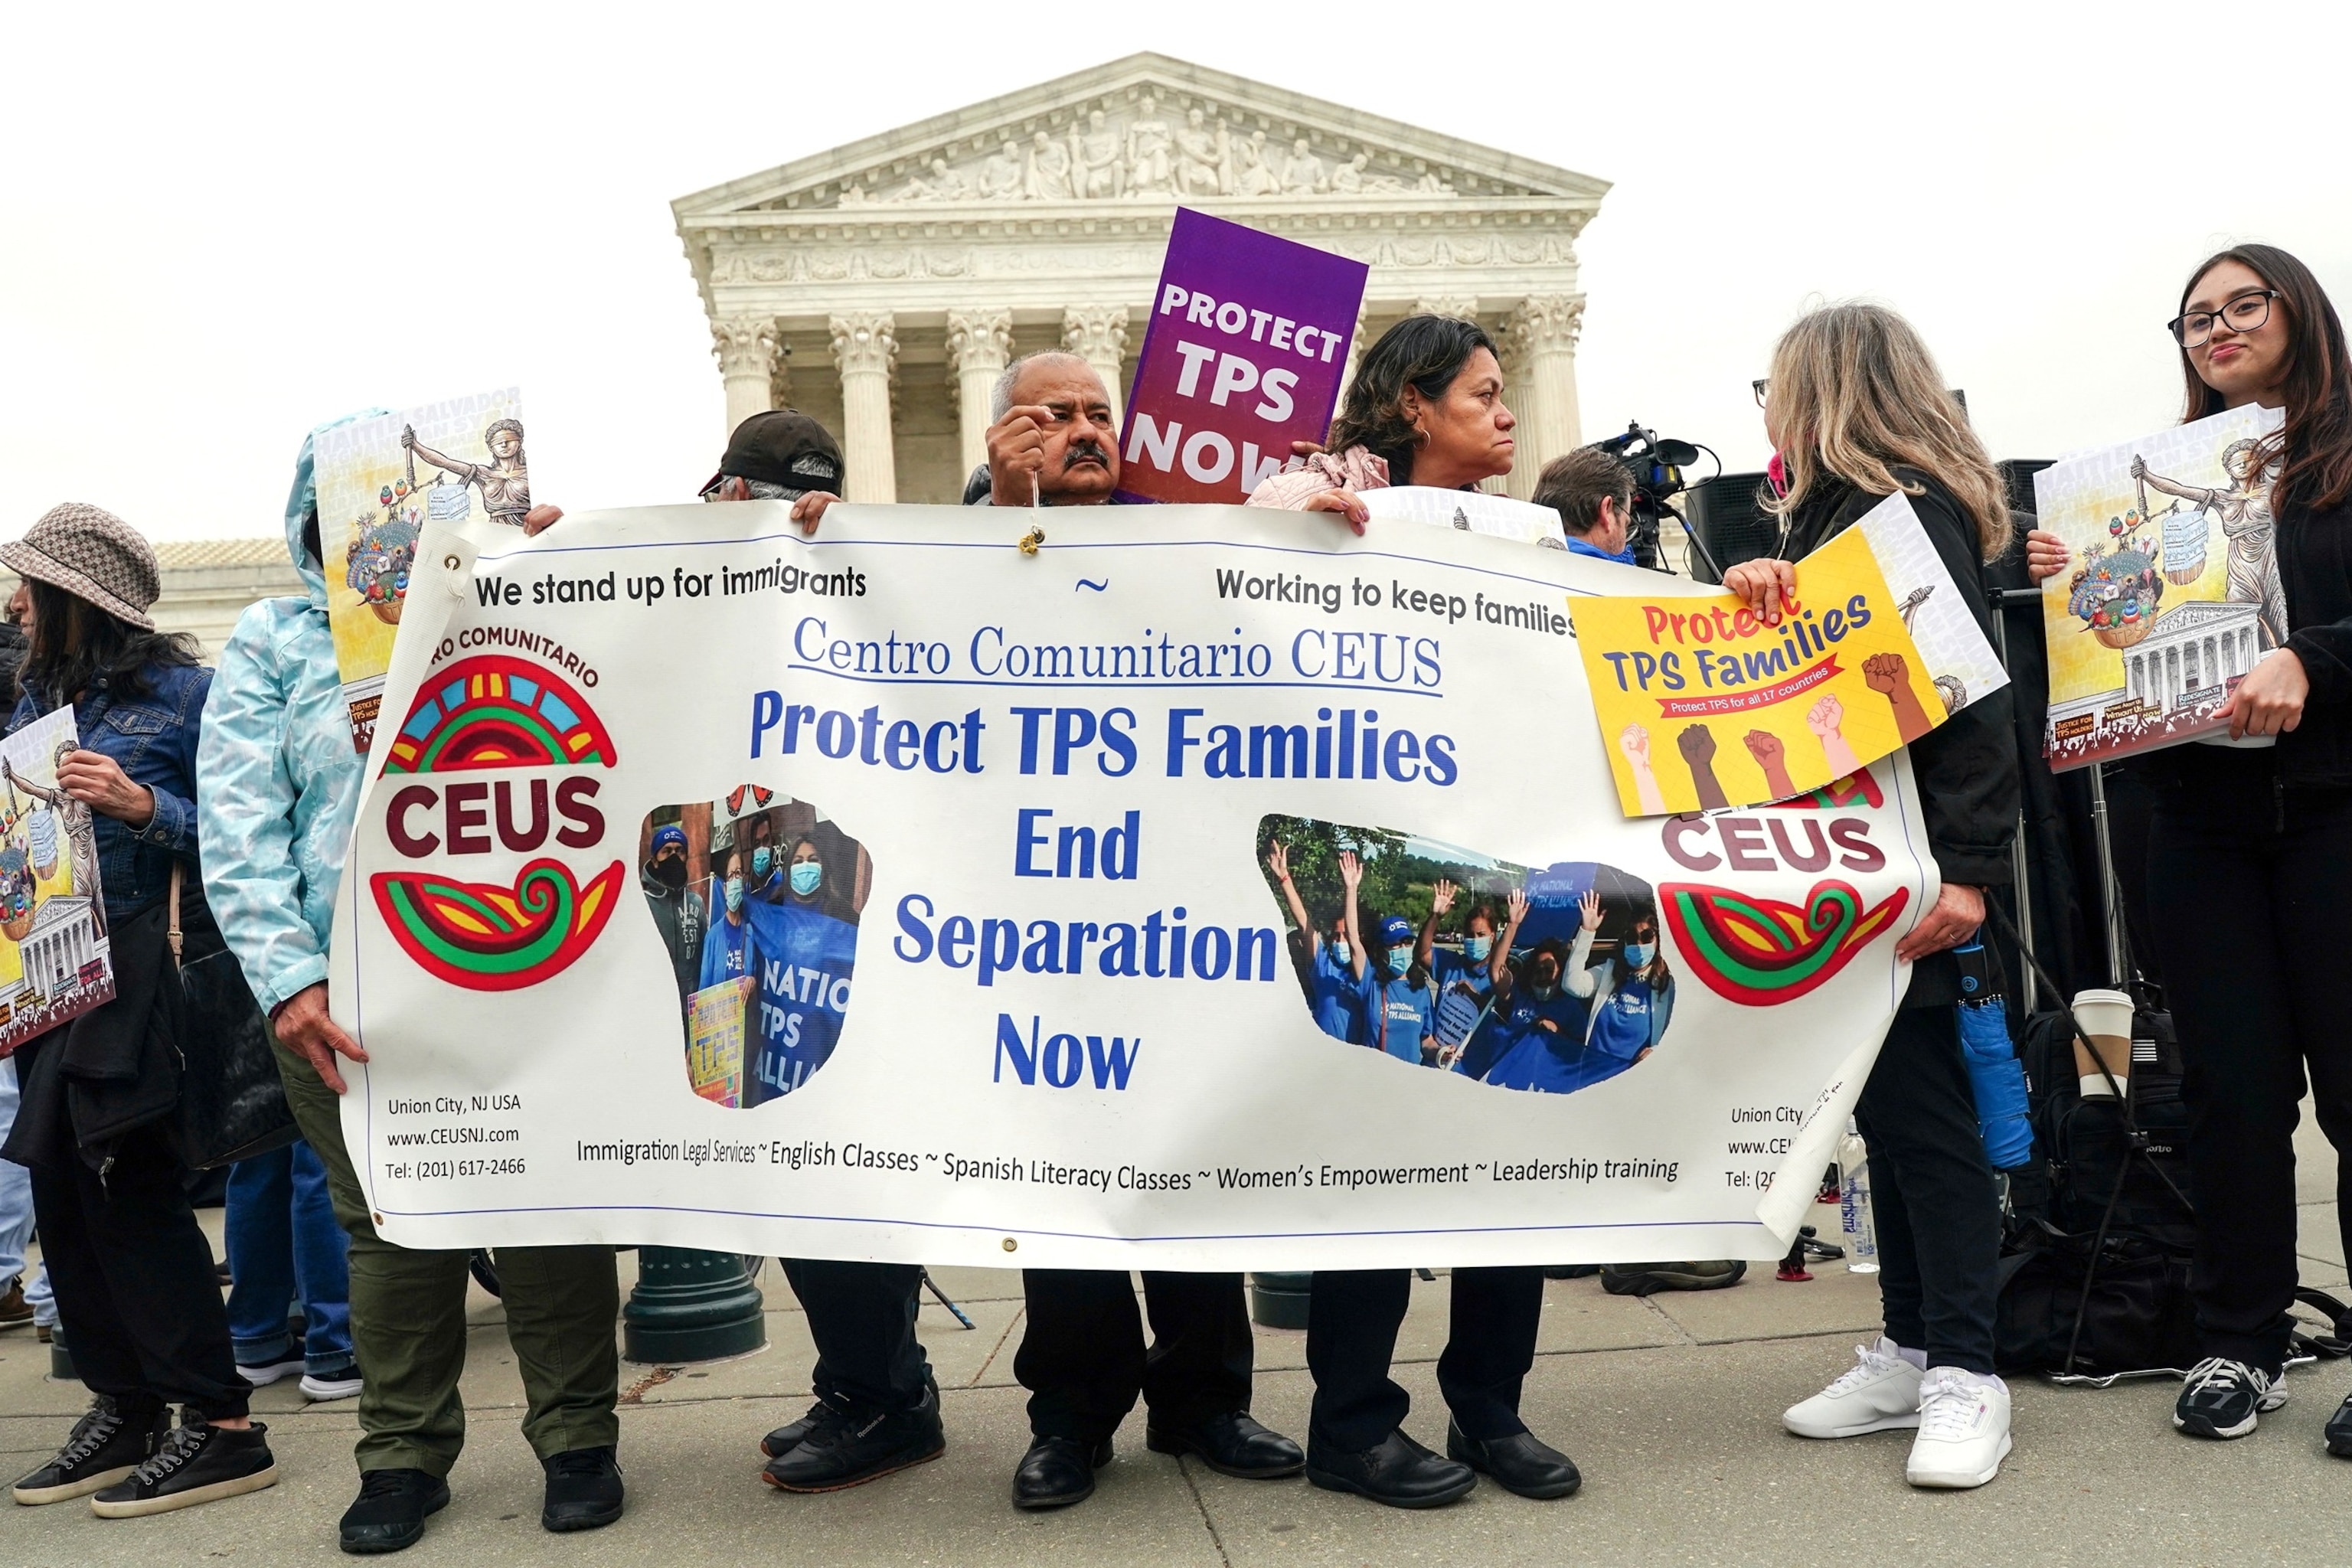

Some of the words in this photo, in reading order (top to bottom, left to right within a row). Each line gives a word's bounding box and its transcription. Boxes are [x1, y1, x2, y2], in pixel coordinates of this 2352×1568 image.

[1086, 250, 1160, 270] JUSTIC
[1160, 283, 1342, 364] PROTECT
[1176, 340, 1299, 422] TPS
[475, 577, 522, 607] We
[533, 571, 616, 604] stand
[627, 576, 665, 606] up
[673, 567, 714, 597] for
[722, 557, 866, 596] immigrants
[1216, 568, 1341, 613] Working
[1352, 577, 1381, 606] to
[1393, 580, 1466, 625] keep
[793, 616, 951, 675] Centro
[969, 626, 1272, 677] Comunitario
[1291, 629, 1442, 687] CEUS
[1602, 649, 1685, 693] TPS
[1694, 595, 1871, 688] Families
[2112, 624, 2145, 642] TPS
[459, 627, 599, 688] COMUNITARIO
[351, 701, 372, 713] JUSTICE
[1671, 702, 1707, 713] Protect
[1708, 700, 1729, 710] TPS
[1730, 697, 1745, 707] for
[1749, 695, 1761, 705] all
[1762, 690, 1775, 701] 17
[1779, 667, 1828, 697] countries
[2178, 686, 2221, 702] REDESIGNATE
[353, 711, 365, 720] TPS
[2056, 720, 2079, 730] JUSTICE
[2080, 716, 2092, 724] FOR
[2056, 730, 2069, 738] TPS
[2070, 725, 2093, 735] HOLDERS
[2106, 709, 2133, 720] WITHOUT
[2143, 709, 2161, 718] NOW
[750, 690, 986, 774] Protect
[1010, 707, 1137, 777] TPS
[1166, 707, 1458, 786] Families
[386, 776, 606, 858] CEUS
[1014, 808, 1140, 880] End
[1661, 815, 1886, 873] CEUS
[893, 893, 1276, 987] Separation
[80, 977, 92, 985] FOR
[93, 969, 103, 979] ALL
[760, 1001, 803, 1047] TPS
[696, 1024, 739, 1071] TPS
[994, 1013, 1141, 1090] Now
[389, 1099, 431, 1115] Union
[436, 1097, 466, 1116] City,
[472, 1096, 487, 1111] NJ
[492, 1094, 521, 1110] USA
[1732, 1107, 1771, 1123] Union
[1776, 1106, 1803, 1125] City
[387, 1128, 518, 1146] www.CEUSNJ.com
[385, 1162, 411, 1178] Tel:
[417, 1160, 454, 1181] (201)
[459, 1158, 525, 1176] 617-2466
[578, 1138, 678, 1165] Immigration
[683, 1138, 710, 1167] Legal
[714, 1140, 755, 1163] Services
[771, 1140, 835, 1171] English
[843, 1143, 918, 1171] Classes
[943, 1152, 1023, 1181] Spanish
[1031, 1161, 1112, 1193] Literacy
[1118, 1165, 1191, 1191] Classes
[1321, 1163, 1469, 1191] Empowerment
[1493, 1158, 1598, 1184] Leadership
[1605, 1158, 1679, 1182] training
[1725, 1171, 1749, 1187] Tel:
